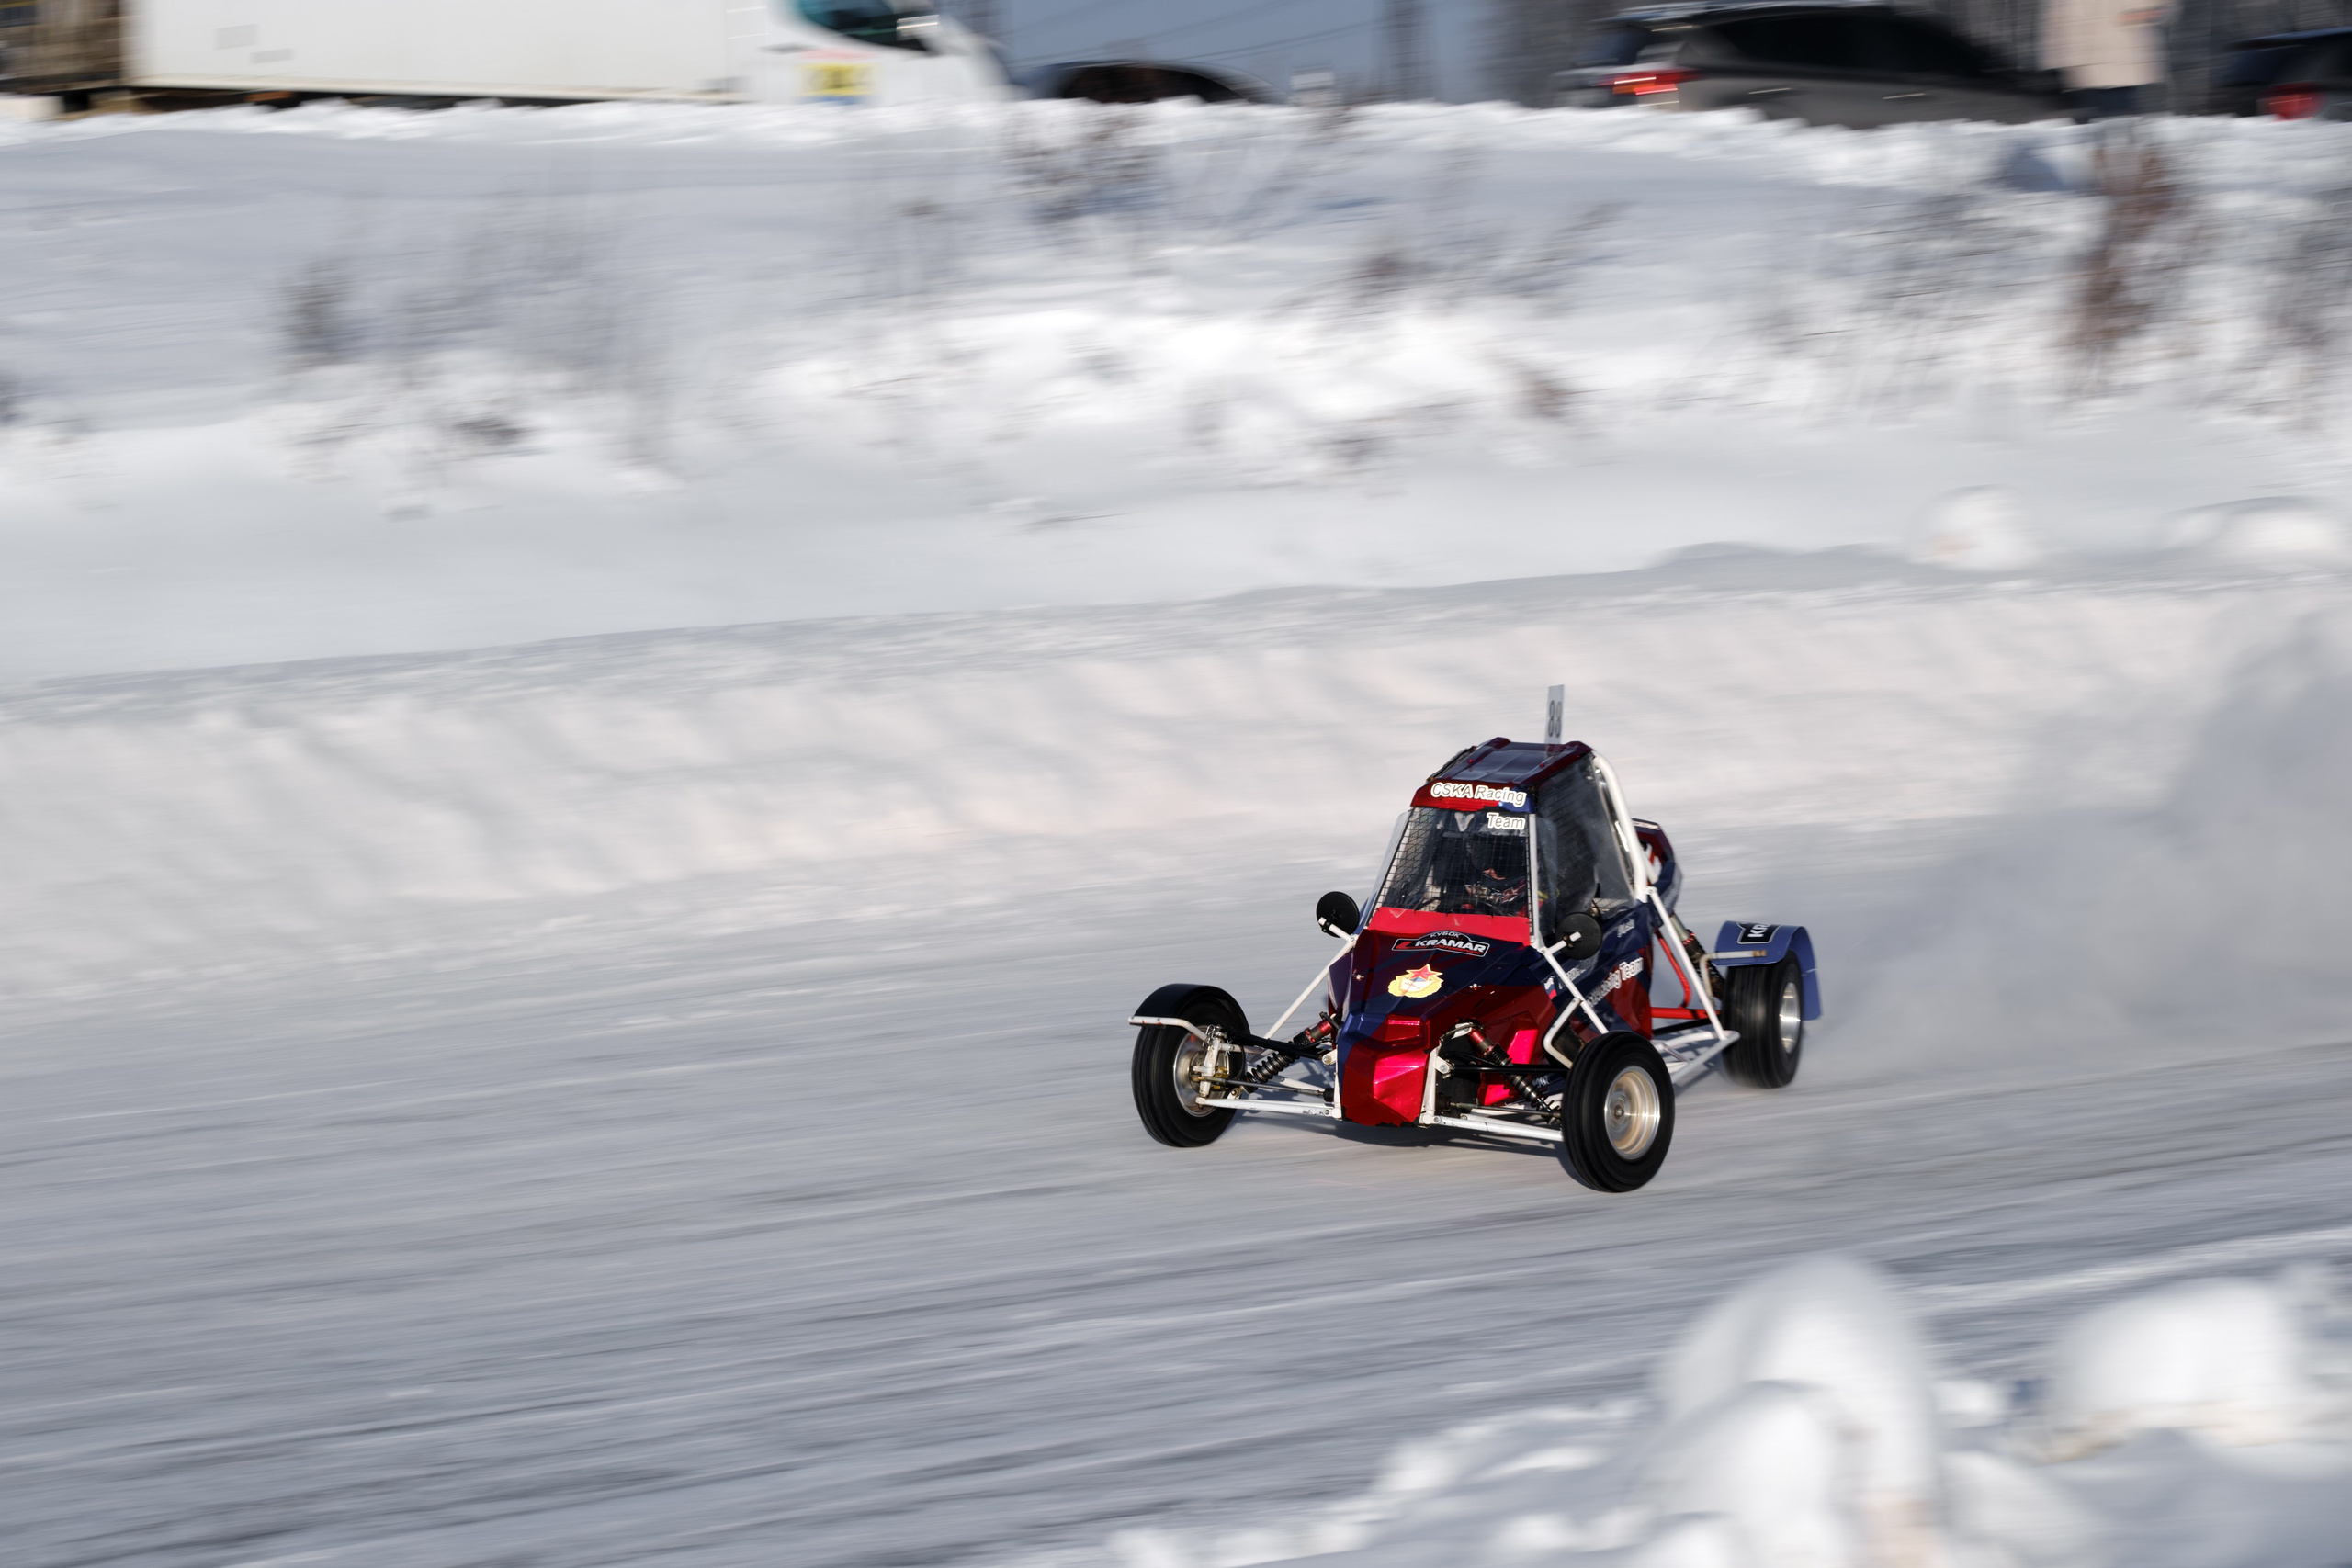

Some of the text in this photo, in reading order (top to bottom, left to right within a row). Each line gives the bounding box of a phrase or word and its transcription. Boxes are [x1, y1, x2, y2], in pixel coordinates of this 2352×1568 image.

[1548, 700, 1562, 738] 88
[1430, 782, 1527, 807] CSKA Racing
[1487, 812, 1526, 830] Team
[1415, 938, 1486, 953] KRAMAR
